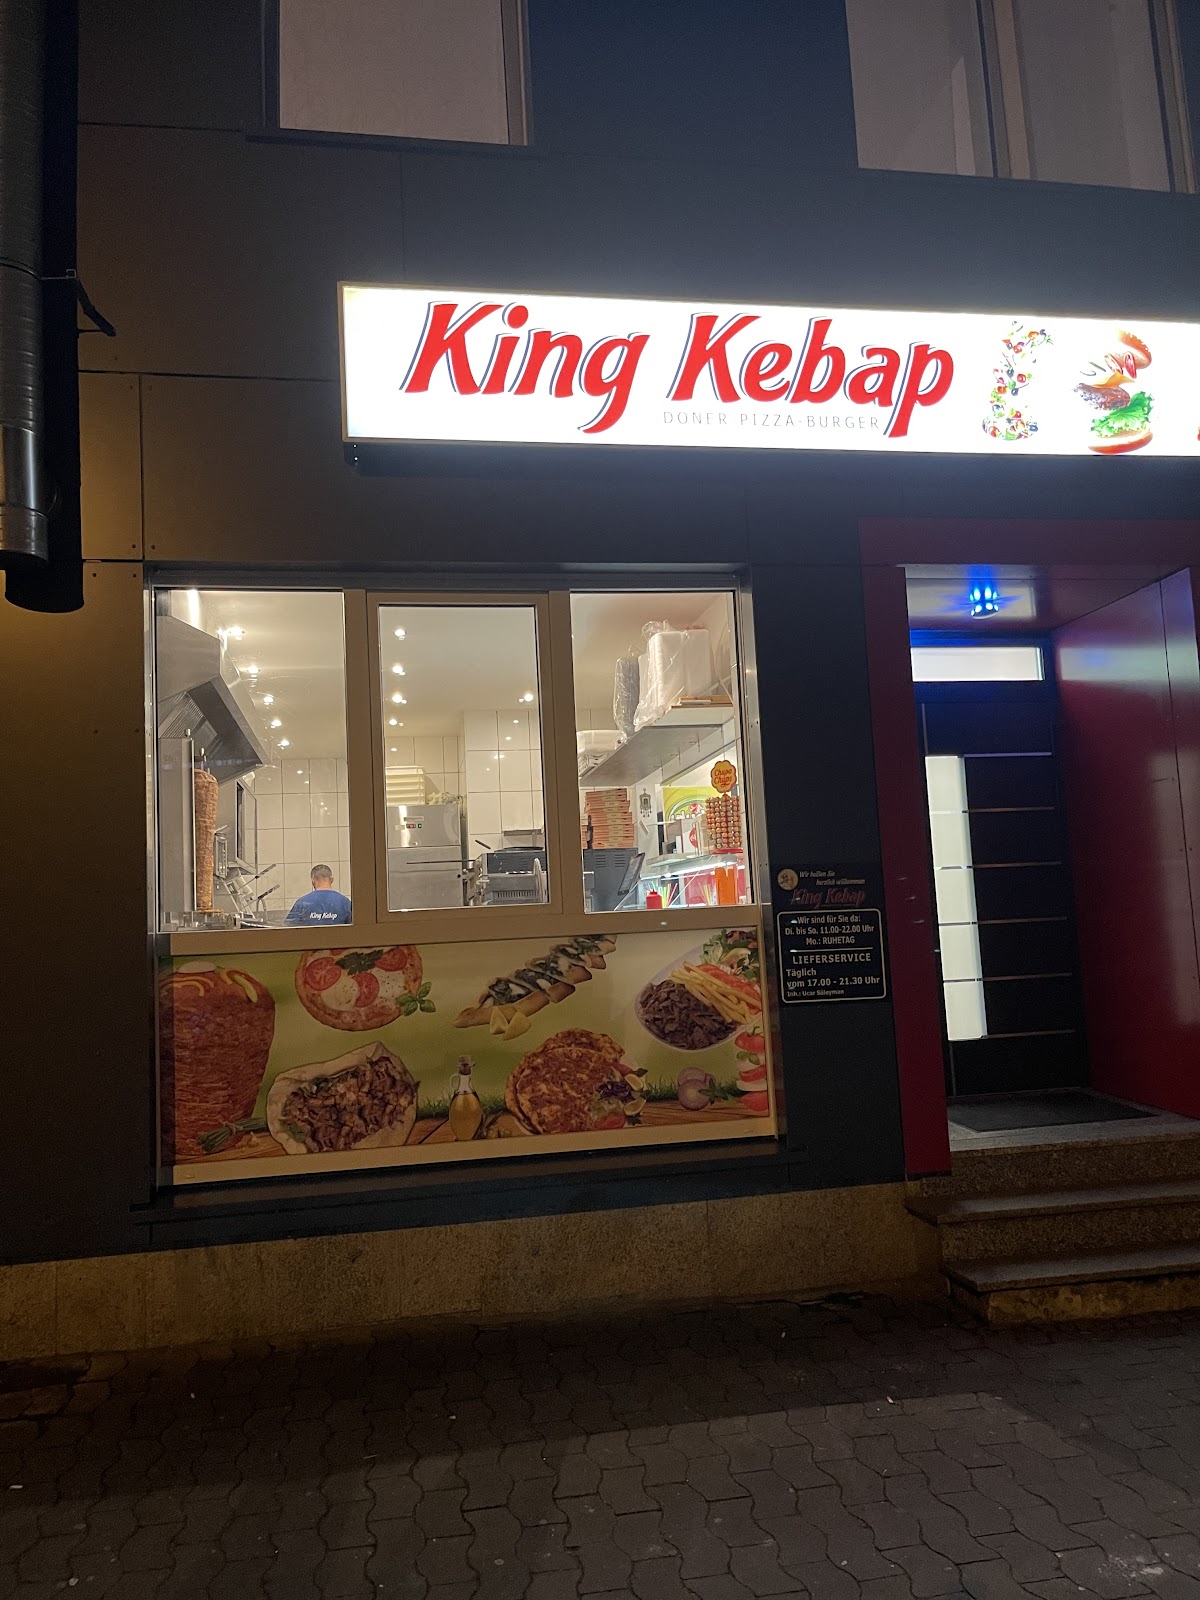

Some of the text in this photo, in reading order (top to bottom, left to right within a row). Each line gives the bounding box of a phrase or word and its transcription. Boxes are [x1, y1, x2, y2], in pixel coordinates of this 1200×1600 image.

[400, 302, 954, 438] King Kebap
[790, 887, 865, 909] King Kebap
[797, 914, 861, 924] Wir sind für Sie da:
[796, 927, 806, 935] bis
[808, 926, 819, 934] So.
[820, 925, 860, 934] 11.00-22.00
[862, 924, 874, 932] Uhr
[823, 936, 855, 944] RUHETAG
[792, 953, 872, 965] LIEFERSERVICE
[786, 968, 817, 978] Täglich
[807, 978, 831, 987] 17.00
[839, 976, 863, 985] 21.30
[864, 976, 880, 984] Uhr
